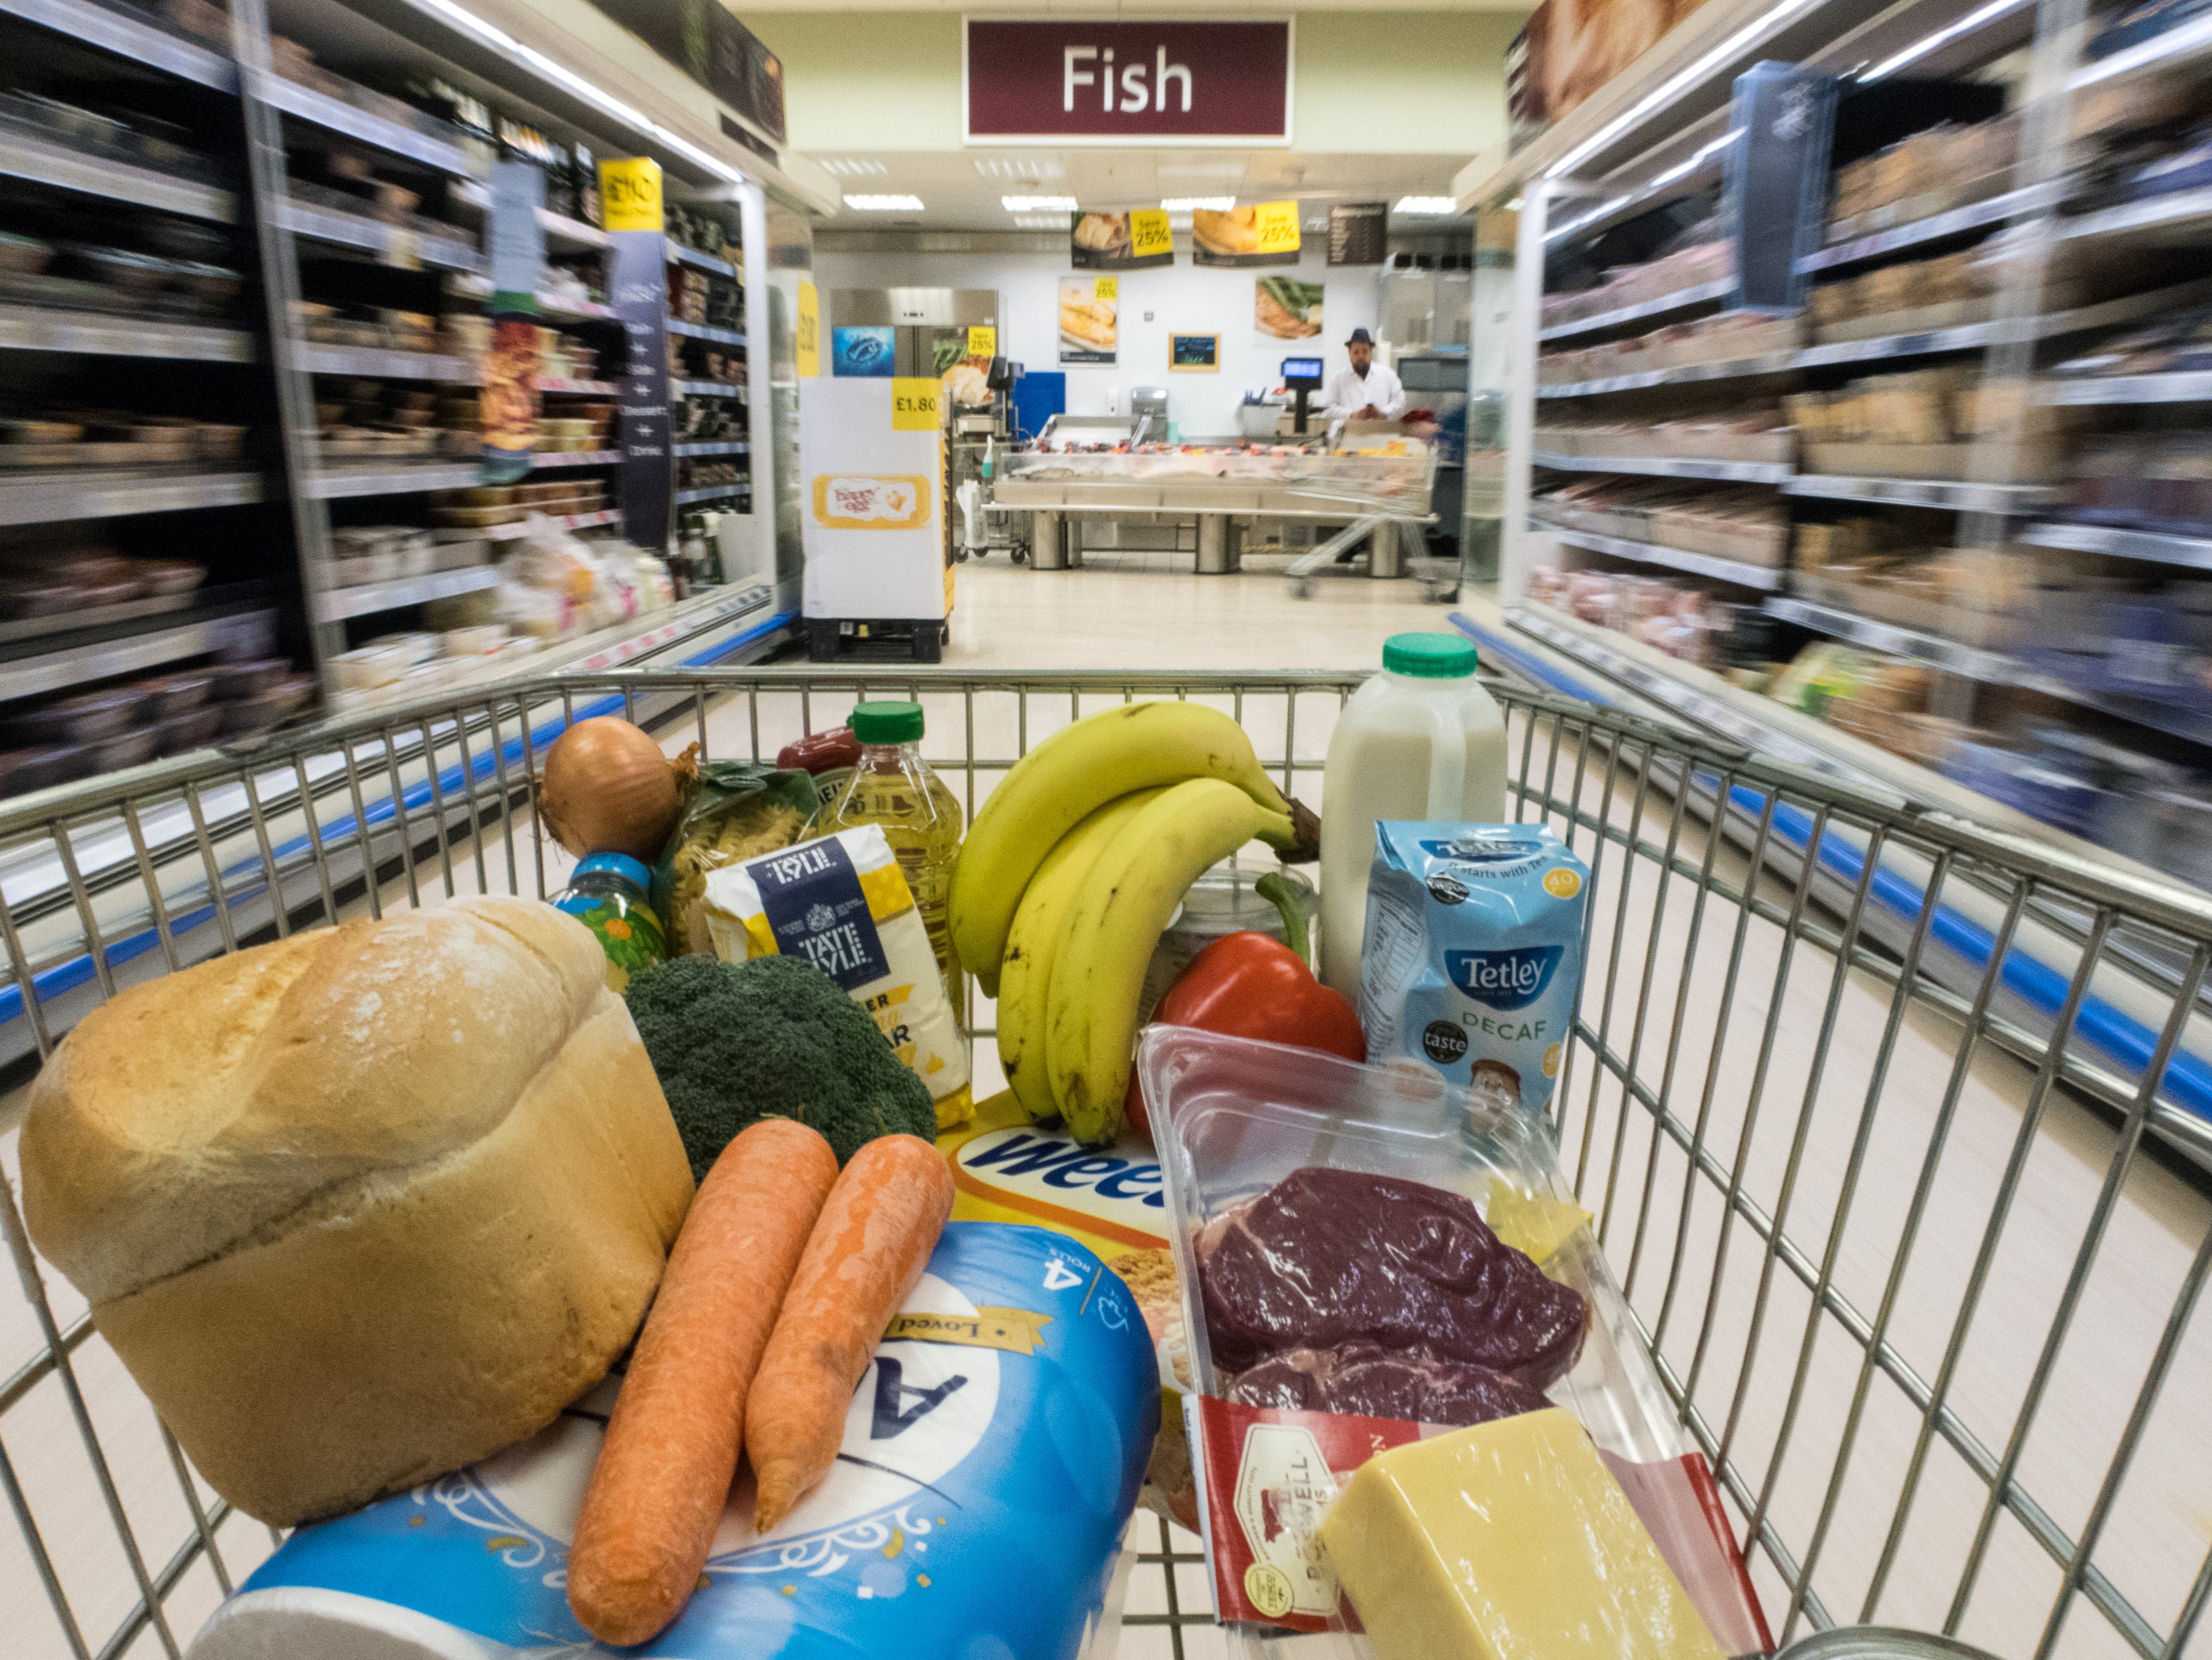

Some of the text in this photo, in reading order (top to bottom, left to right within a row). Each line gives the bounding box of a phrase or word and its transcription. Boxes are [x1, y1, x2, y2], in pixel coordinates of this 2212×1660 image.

[1064, 44, 1192, 113] Fish
[1135, 229, 1169, 247] 25%
[1261, 224, 1295, 243] 25%
[1095, 288, 1117, 299] 25%
[972, 340, 994, 350] 25%
[896, 397, 936, 412] £1.80
[1461, 867, 1497, 879] starts
[1500, 864, 1528, 878] with
[1531, 855, 1549, 870] Tea
[1461, 956, 1548, 995] Tetley
[1462, 1012, 1547, 1041] DECAF
[1425, 1032, 1466, 1053] taste
[963, 1134, 1165, 1207] Wee
[1044, 1258, 1083, 1291] 4
[899, 1318, 982, 1340] Loved
[1266, 1573, 1278, 1611] TESCO
